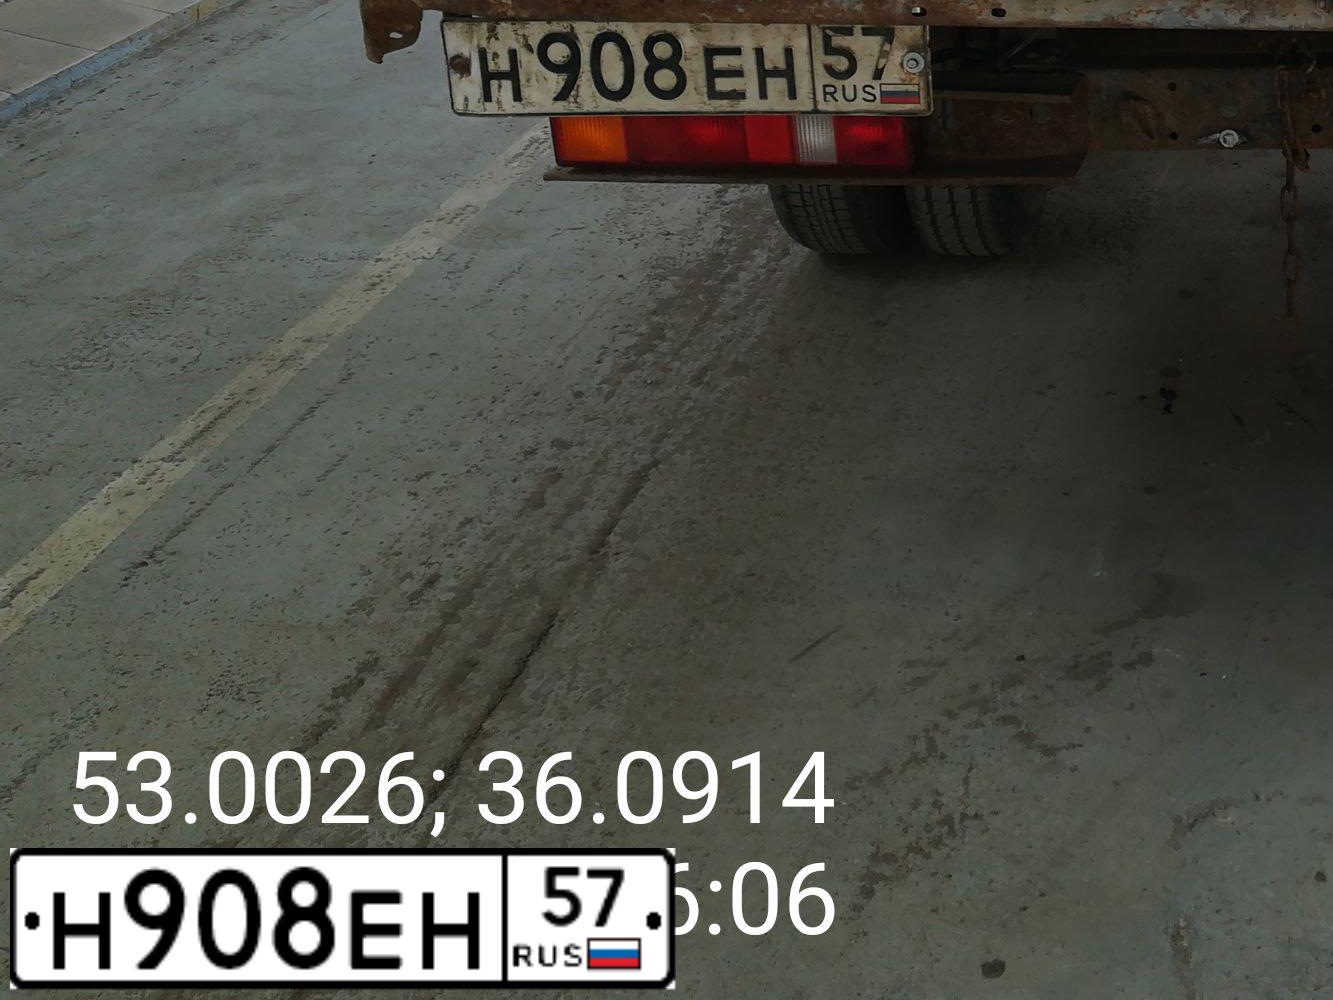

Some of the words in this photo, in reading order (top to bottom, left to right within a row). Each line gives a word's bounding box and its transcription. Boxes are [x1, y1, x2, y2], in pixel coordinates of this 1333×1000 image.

[477, 29, 798, 103] Н908ЕН
[822, 26, 895, 81] 57
[822, 84, 877, 103] RUS
